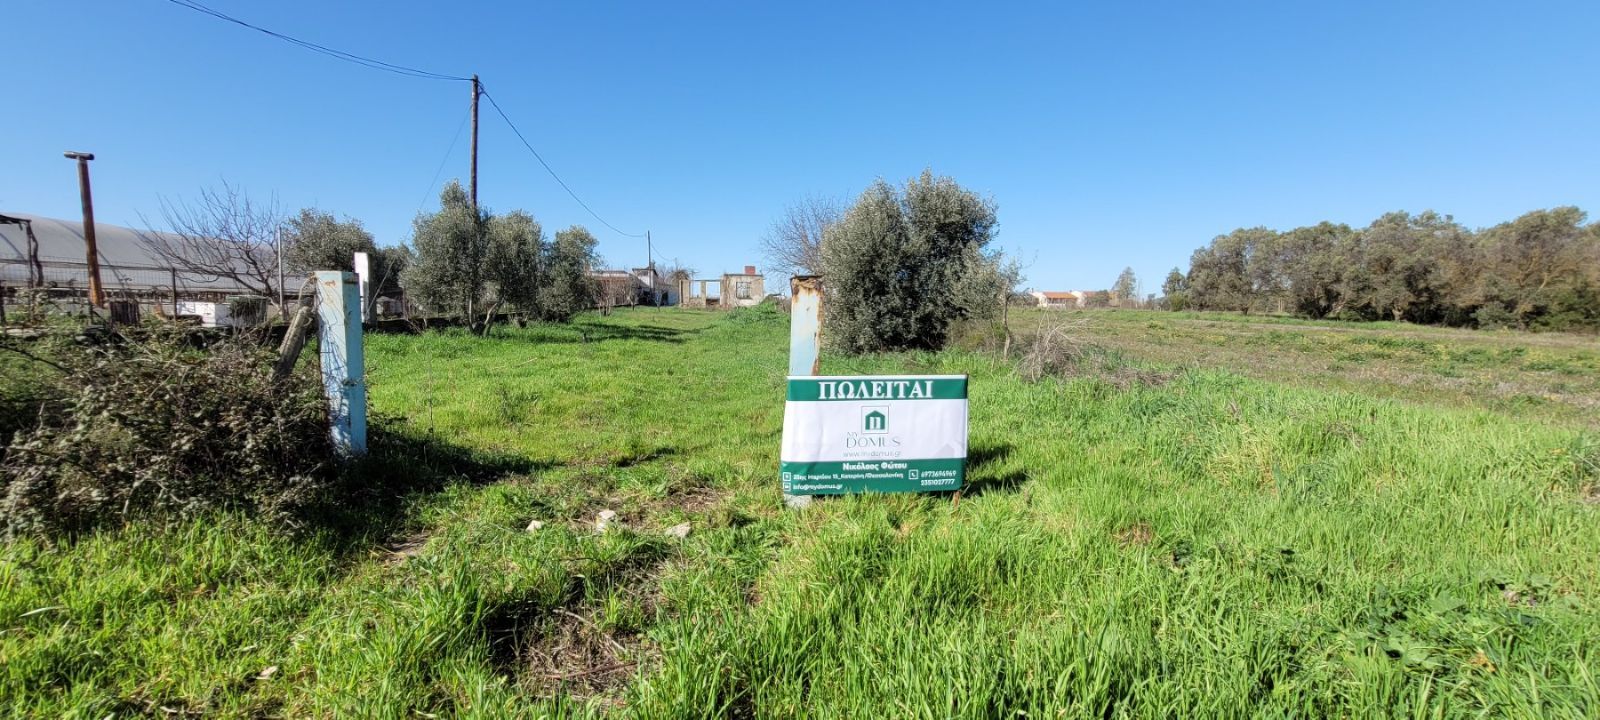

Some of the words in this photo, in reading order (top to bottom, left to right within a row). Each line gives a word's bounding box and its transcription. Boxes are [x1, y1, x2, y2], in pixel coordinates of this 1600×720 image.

[818, 380, 933, 400] ΠΩΛΕΙΤΑΙ
[846, 436, 901, 449] DOMUS
[843, 461, 880, 471] Νικόλαος
[881, 461, 908, 470] Φώτου
